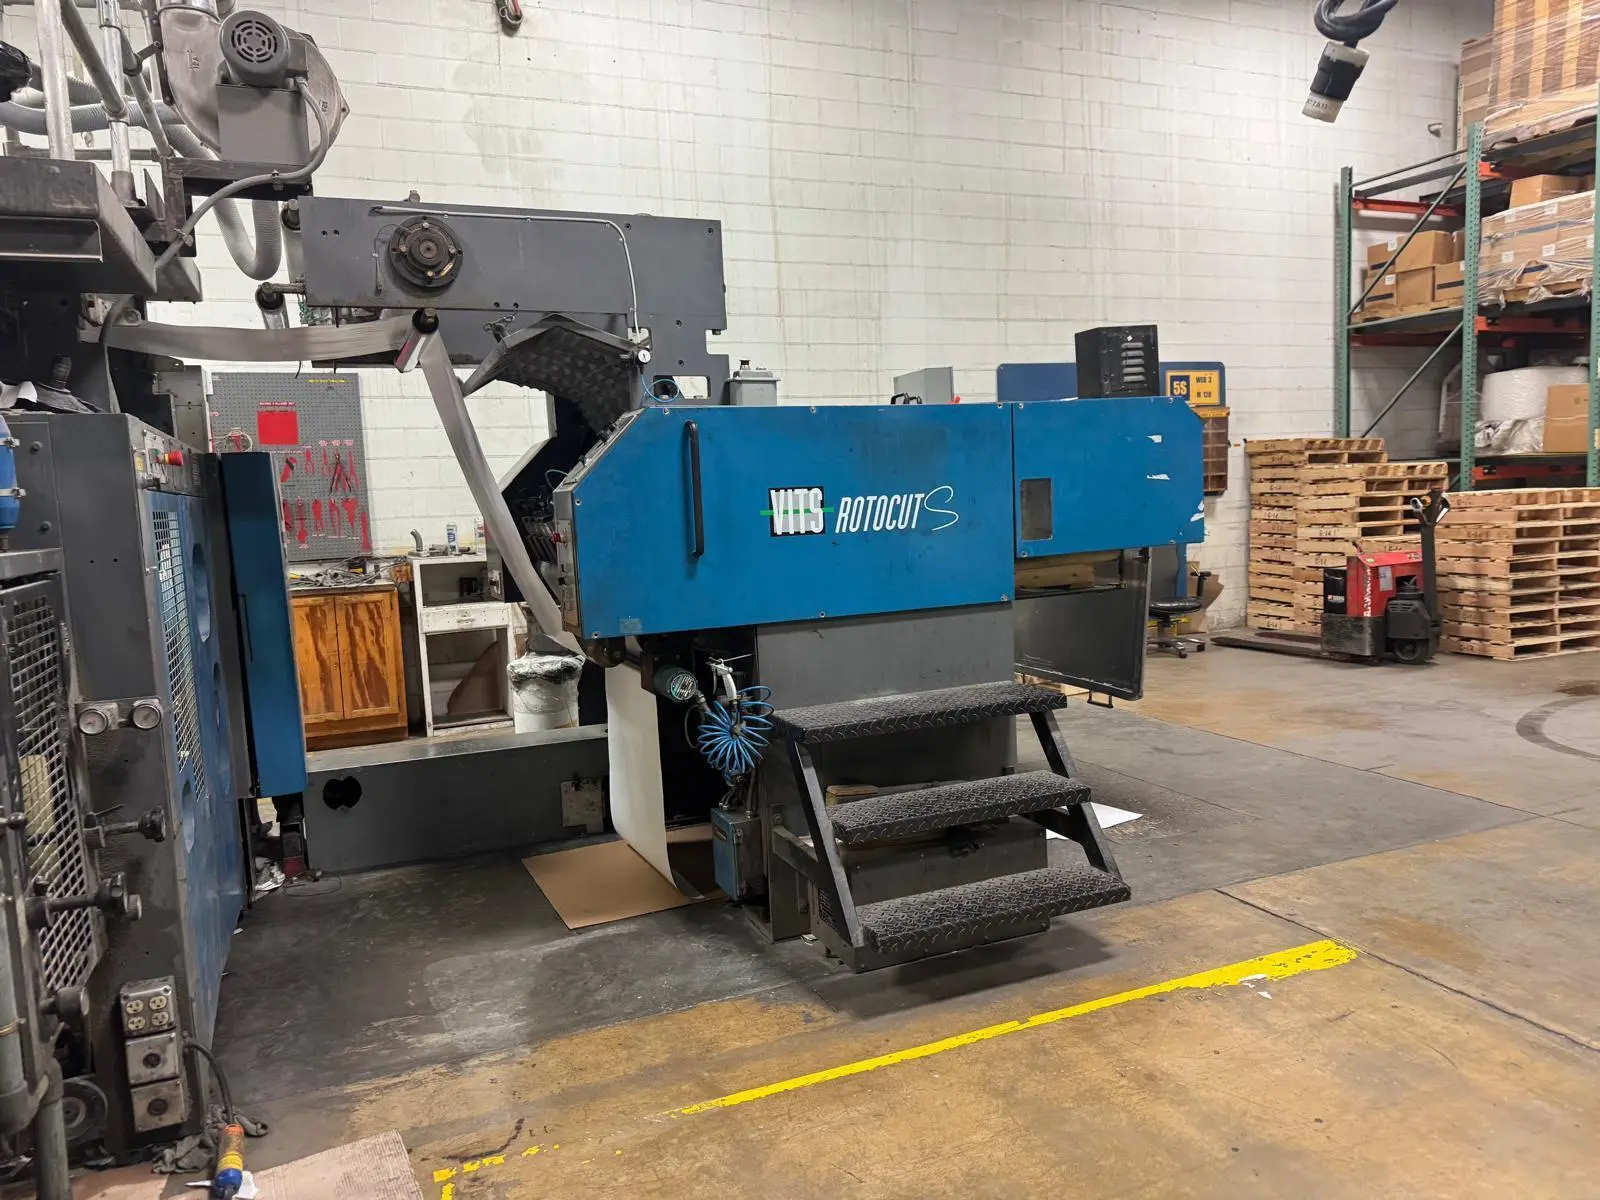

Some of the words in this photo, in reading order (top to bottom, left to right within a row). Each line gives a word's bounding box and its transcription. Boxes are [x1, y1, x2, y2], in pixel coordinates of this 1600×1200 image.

[1173, 381, 1187, 395] 5S
[770, 487, 824, 535] VITS
[835, 493, 926, 533] ROTOCUT
